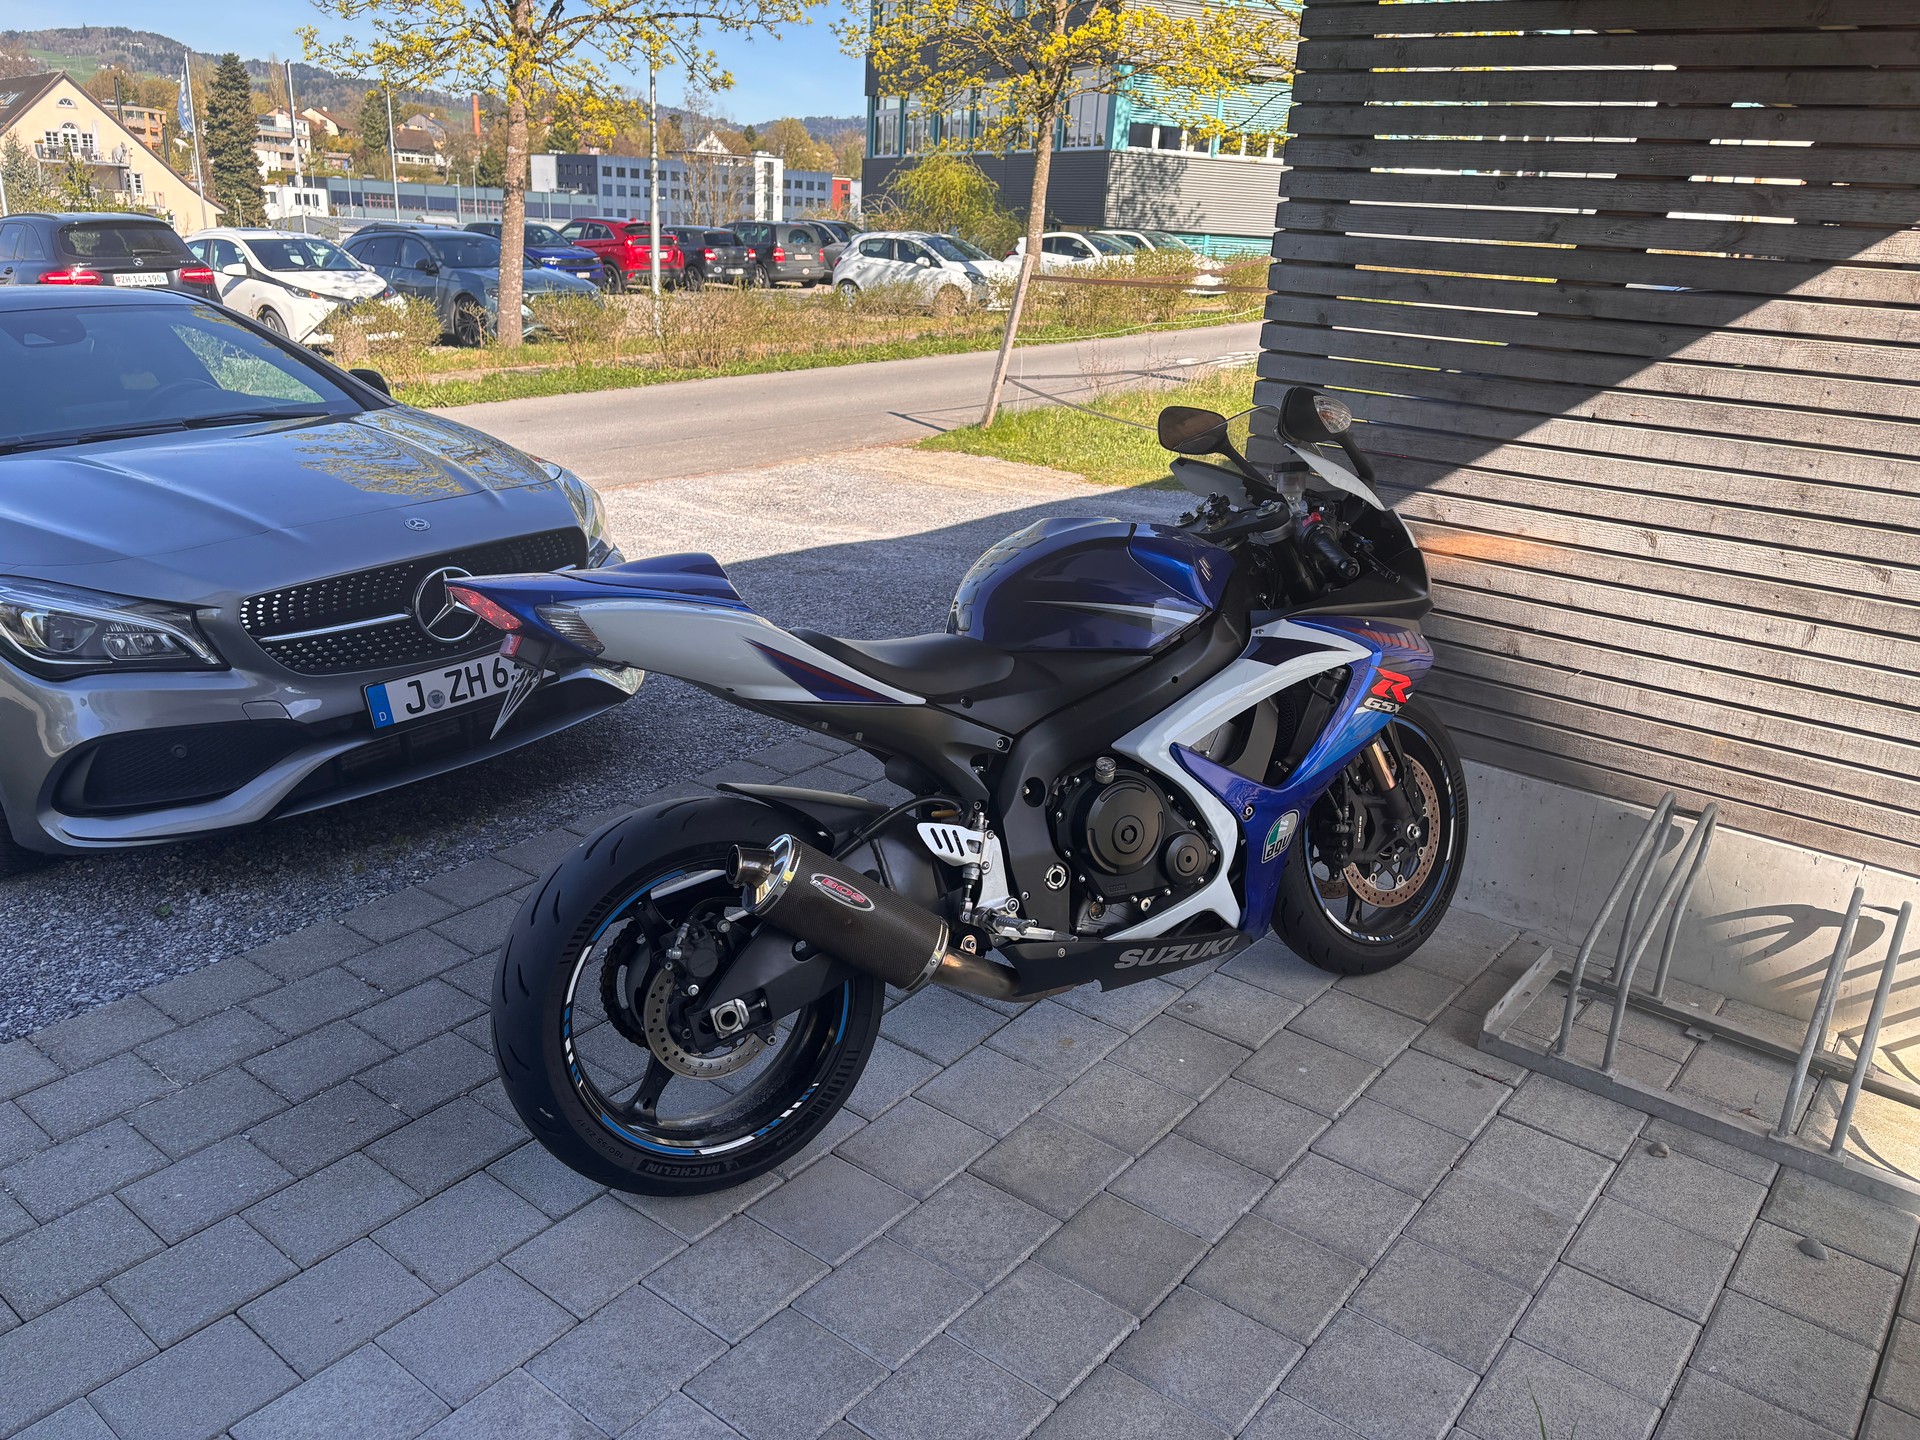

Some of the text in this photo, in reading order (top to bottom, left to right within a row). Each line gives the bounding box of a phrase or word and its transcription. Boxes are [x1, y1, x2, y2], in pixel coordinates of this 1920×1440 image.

[405, 679, 426, 715] J
[444, 662, 488, 704] ZH
[1371, 666, 1412, 704] R
[378, 710, 388, 722] D
[1363, 697, 1403, 714] GSX
[821, 877, 866, 904] BOS
[1113, 934, 1240, 969] SUZUKI
[643, 1161, 722, 1178] MICHELIN
